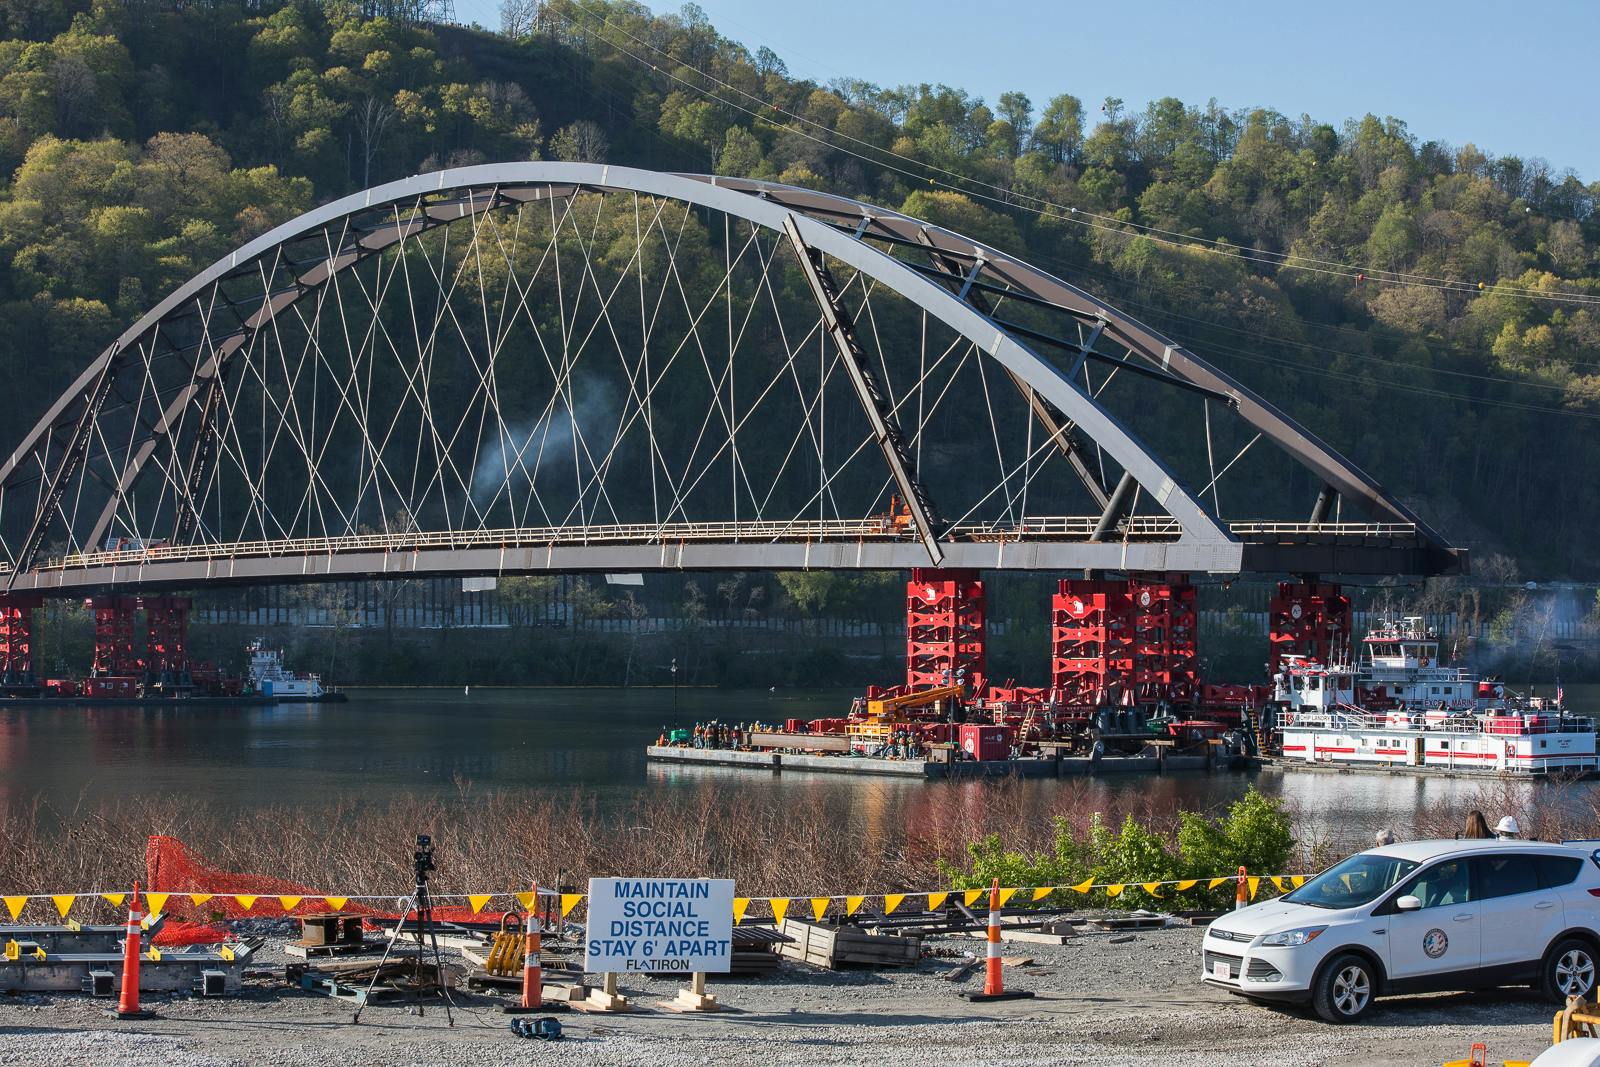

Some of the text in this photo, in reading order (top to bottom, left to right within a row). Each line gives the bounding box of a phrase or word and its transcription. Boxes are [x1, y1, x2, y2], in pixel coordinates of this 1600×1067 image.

[1452, 699, 1477, 707] MARINE
[615, 882, 709, 899] MAINTAIN
[623, 901, 698, 918] SOCIAL
[610, 920, 710, 937] DISTANCE
[588, 939, 730, 957] STAY 6' APART
[626, 959, 690, 970] FLATIRON
